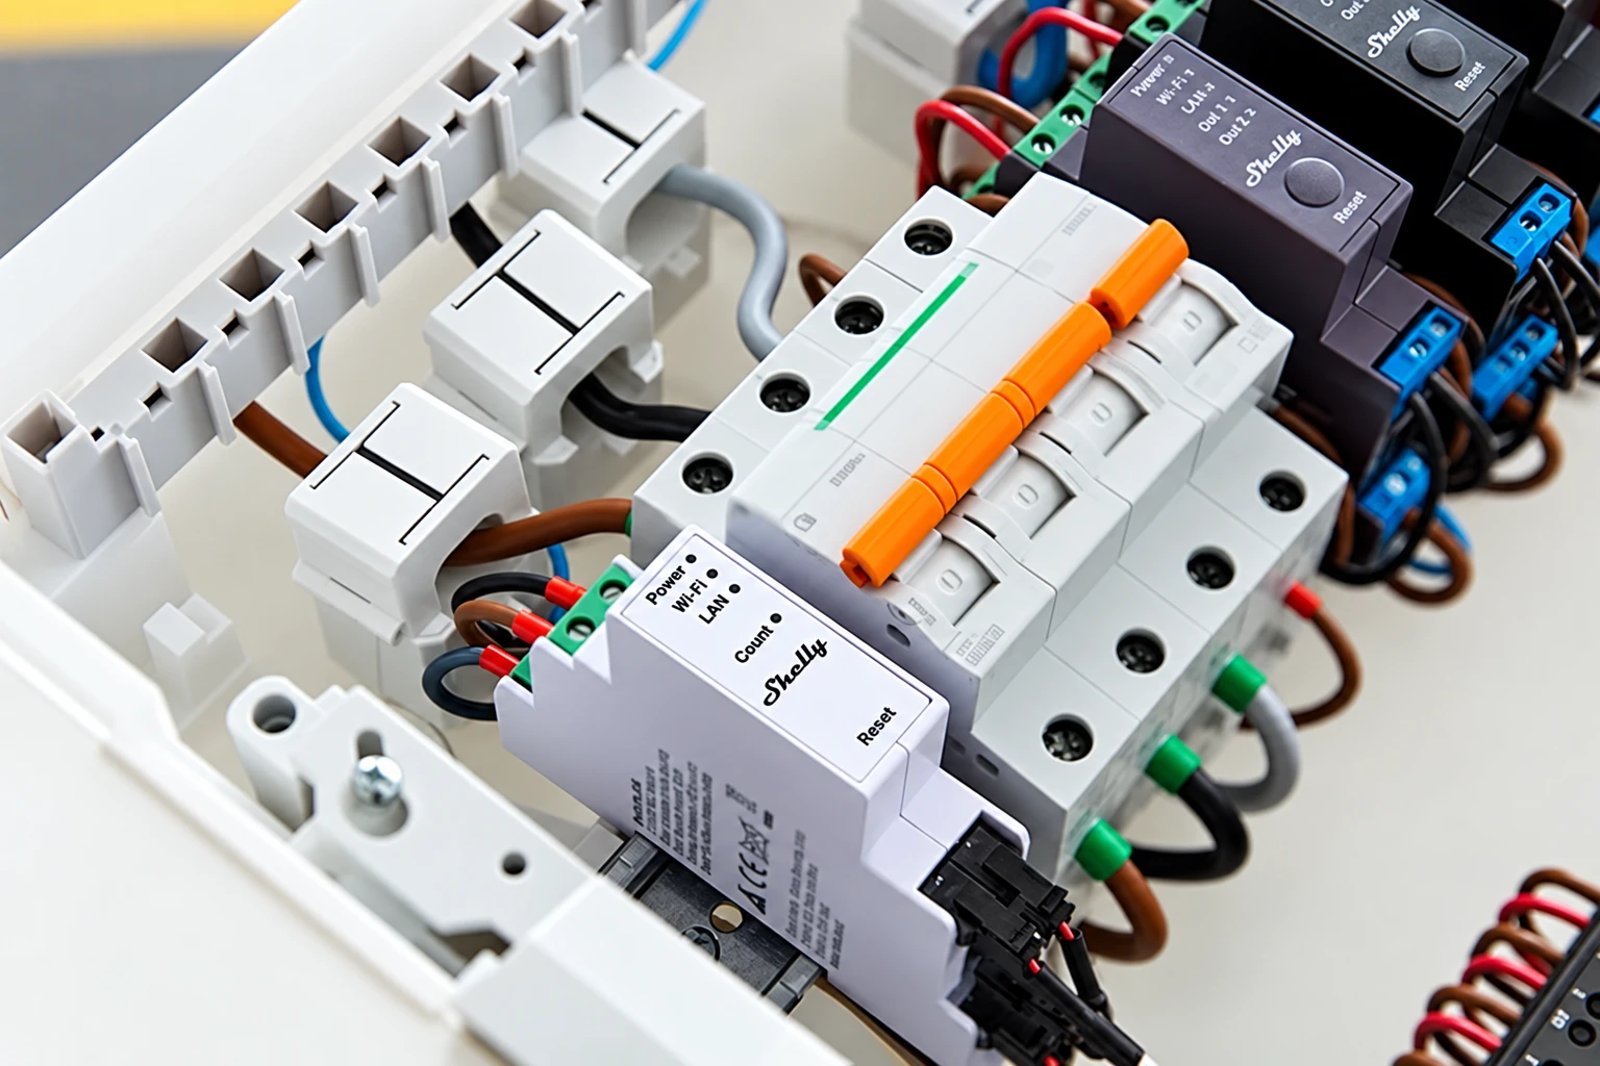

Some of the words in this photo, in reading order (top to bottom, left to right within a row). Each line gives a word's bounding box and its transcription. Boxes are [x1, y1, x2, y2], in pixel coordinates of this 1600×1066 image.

[1367, 5, 1421, 58] Shelly
[1454, 61, 1486, 92] Reset
[1218, 124, 1243, 146] Out
[1246, 130, 1302, 187] Shelly
[1333, 191, 1367, 225] Reset
[645, 565, 686, 605] Power
[672, 578, 708, 614] Wi-Fi
[698, 593, 730, 625] LAN
[734, 625, 774, 664] Count
[763, 638, 828, 707] Shelly
[856, 706, 897, 746] Reset
